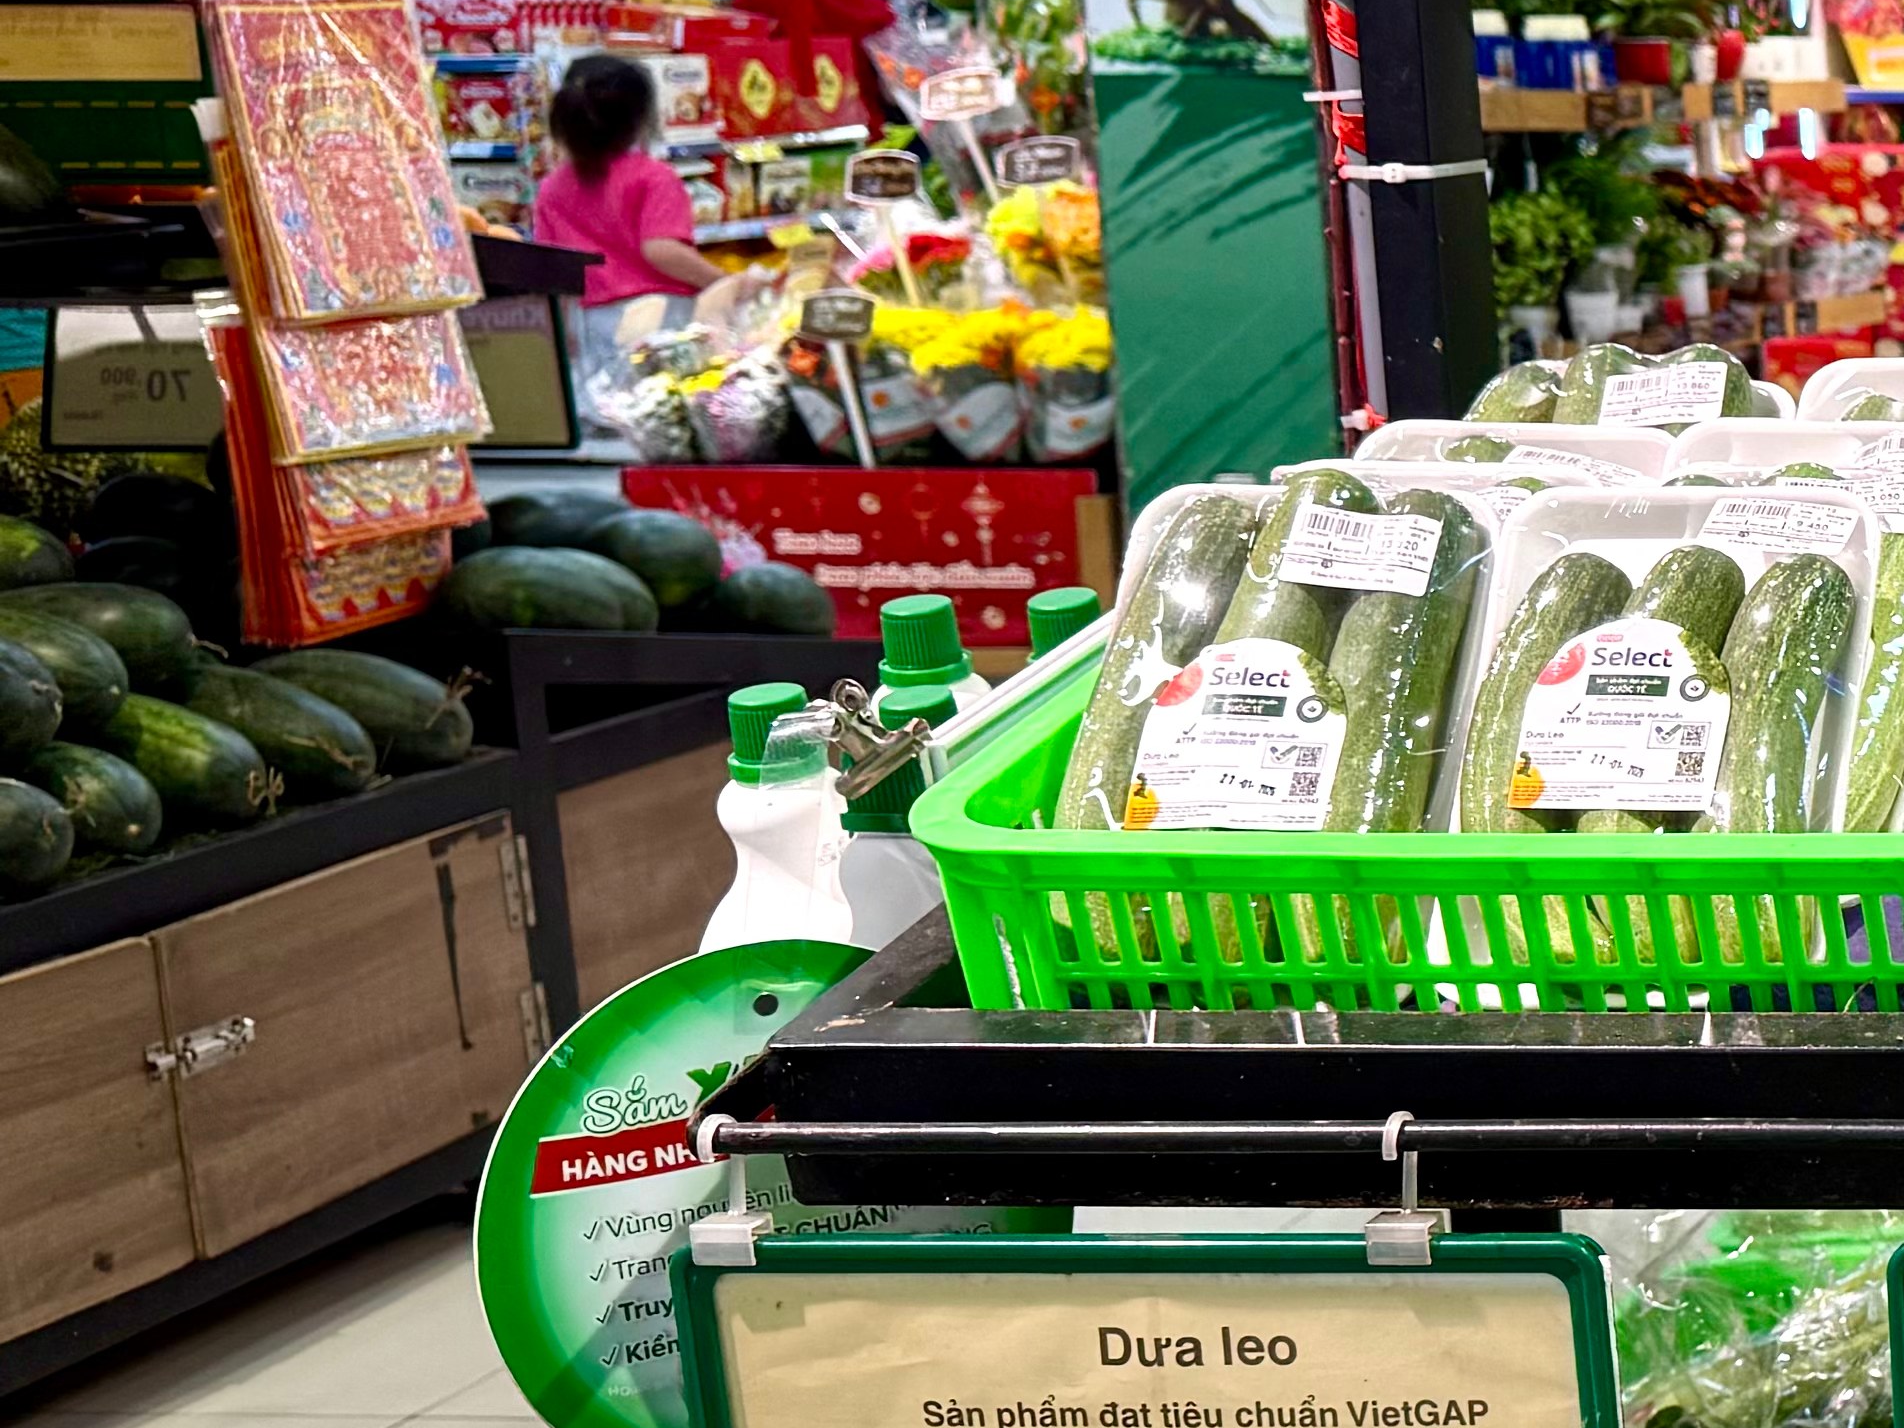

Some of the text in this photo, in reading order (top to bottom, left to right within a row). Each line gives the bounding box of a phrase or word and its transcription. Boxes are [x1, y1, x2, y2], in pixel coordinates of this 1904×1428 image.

[1591, 647, 1673, 668] Select
[1208, 666, 1291, 688] Select
[583, 1076, 688, 1132] Sắm
[561, 1146, 649, 1183] HÀNG
[605, 1204, 674, 1243] Vùng
[1098, 1325, 1299, 1367] Dưa leo
[922, 1397, 991, 1428] Sản
[1160, 1400, 1224, 1428] tiêu
[1234, 1394, 1340, 1428] chuẩn
[1346, 1399, 1490, 1428] VietGAP
